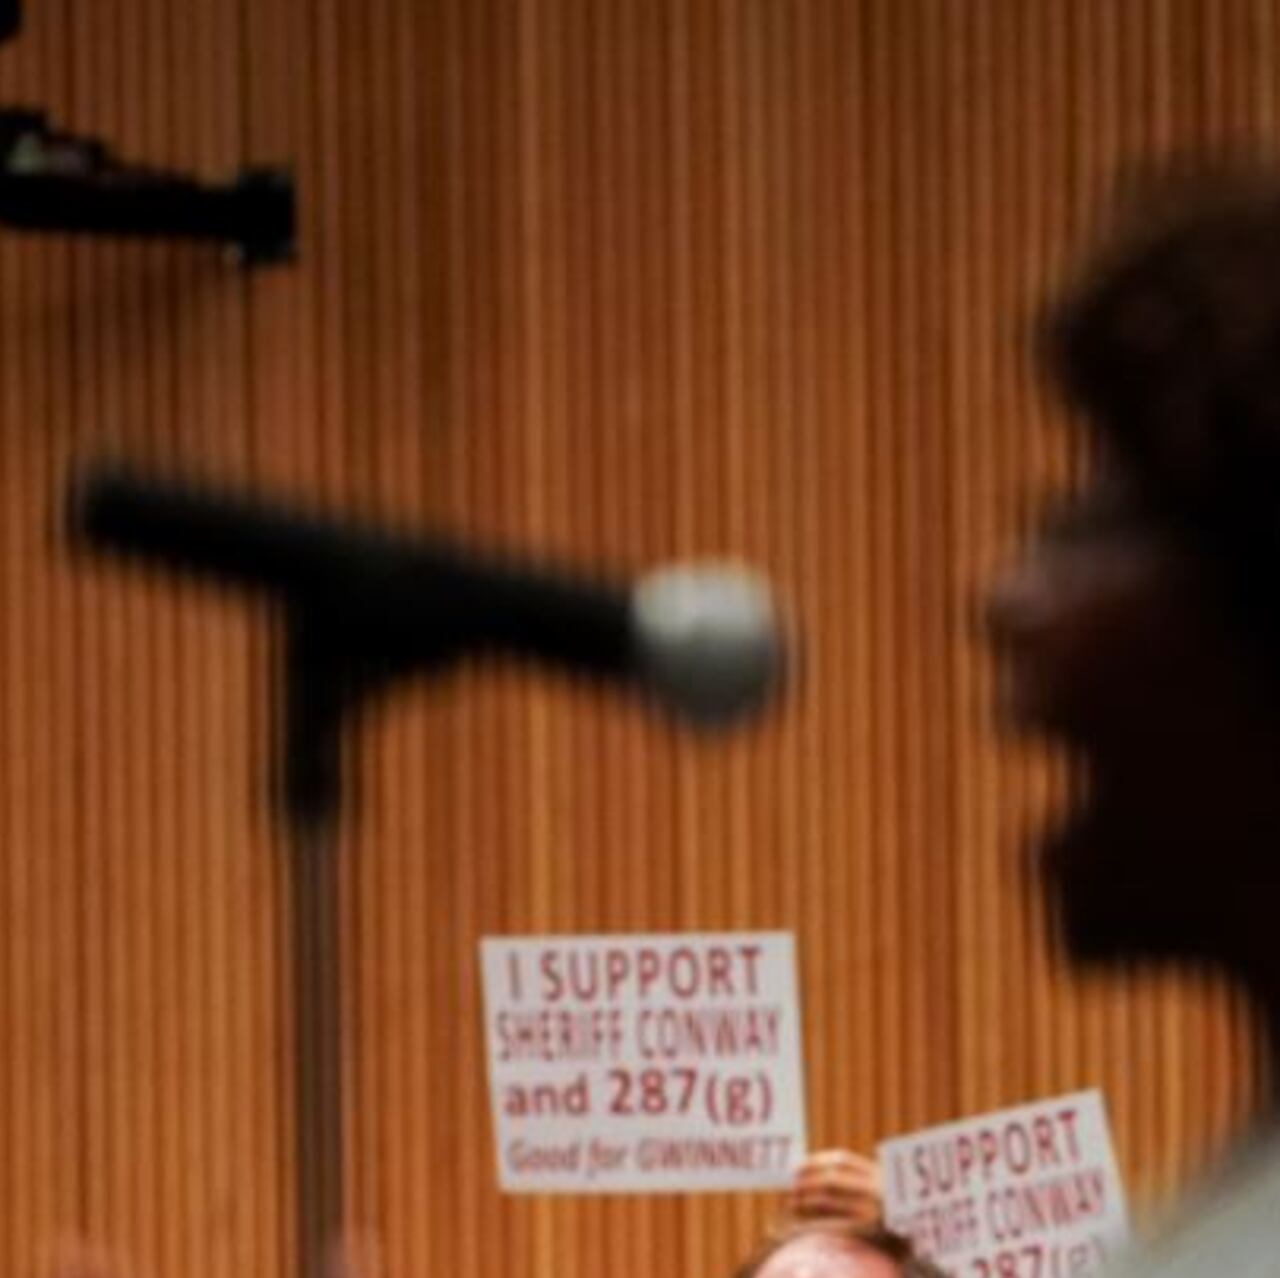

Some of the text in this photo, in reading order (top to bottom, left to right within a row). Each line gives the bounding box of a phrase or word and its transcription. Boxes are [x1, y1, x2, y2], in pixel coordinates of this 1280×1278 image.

[508, 946, 762, 1002] I SUPPORT
[497, 1007, 780, 1062] SHERIFF CONWAY
[503, 1067, 774, 1126] and 287(g)
[509, 1134, 793, 1179] Good for GWINNETT
[912, 1109, 1081, 1198] SUPPORT
[986, 1168, 1106, 1242] CONWAY
